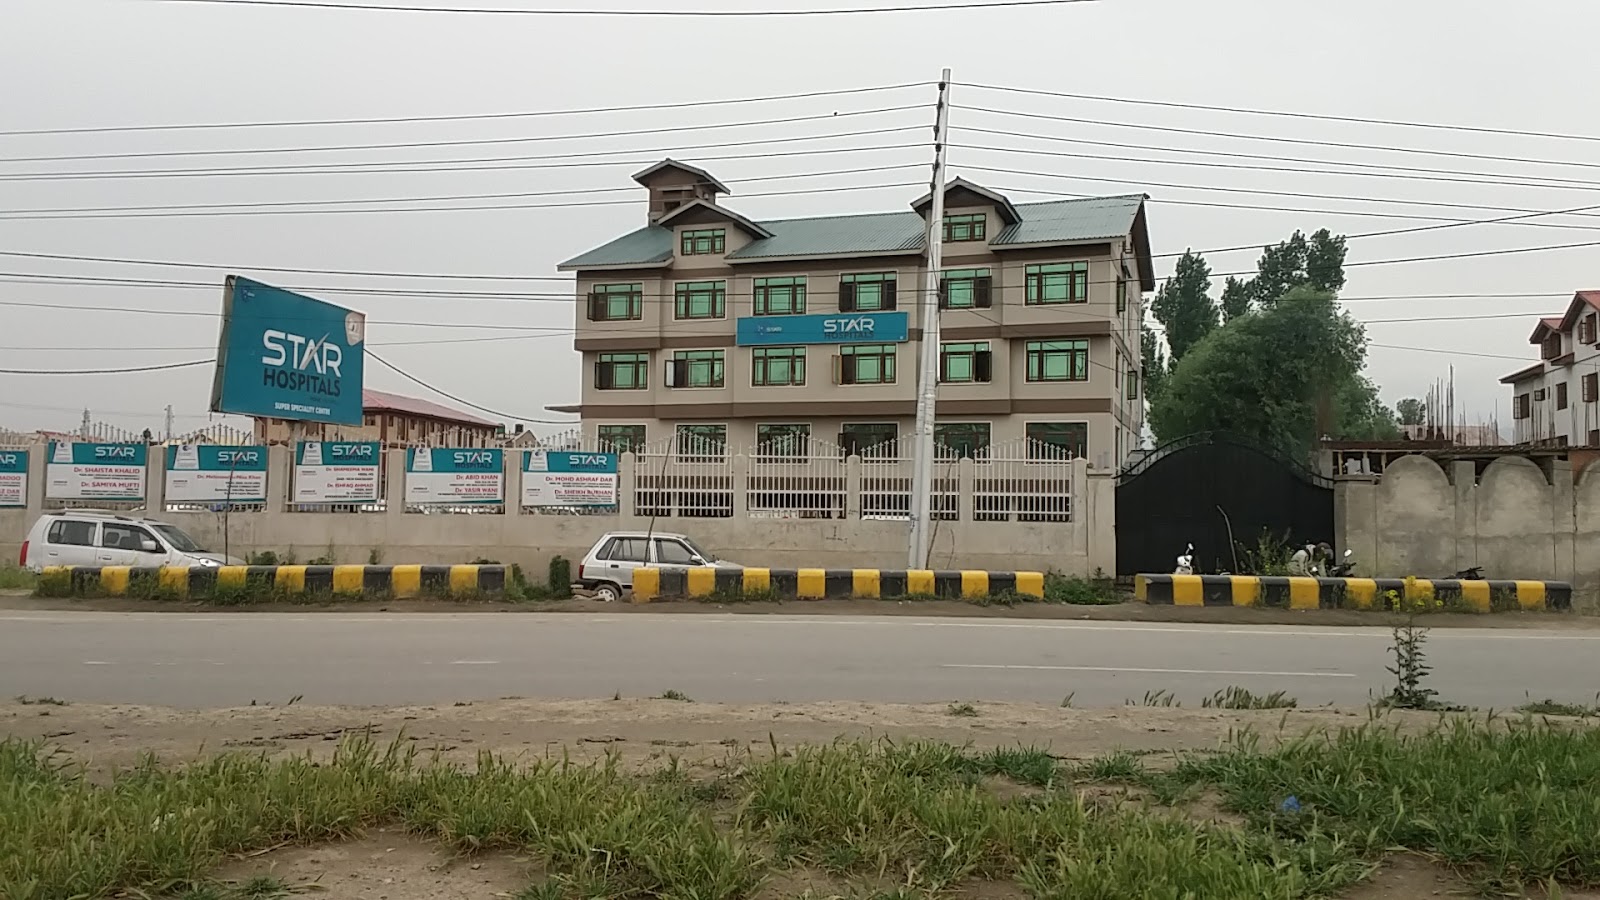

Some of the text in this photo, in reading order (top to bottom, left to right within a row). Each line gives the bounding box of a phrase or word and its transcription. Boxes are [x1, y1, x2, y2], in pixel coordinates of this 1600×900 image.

[823, 315, 875, 333] STAR
[824, 331, 874, 340] HOSPITALS
[262, 329, 342, 378] STAR
[263, 368, 341, 397] HOSPITALS
[275, 402, 290, 411] SUPER
[95, 446, 135, 457] STAR
[332, 445, 372, 456] STAR
[218, 451, 258, 462] STAR
[454, 452, 493, 463] STAR
[569, 455, 607, 465] STAR
